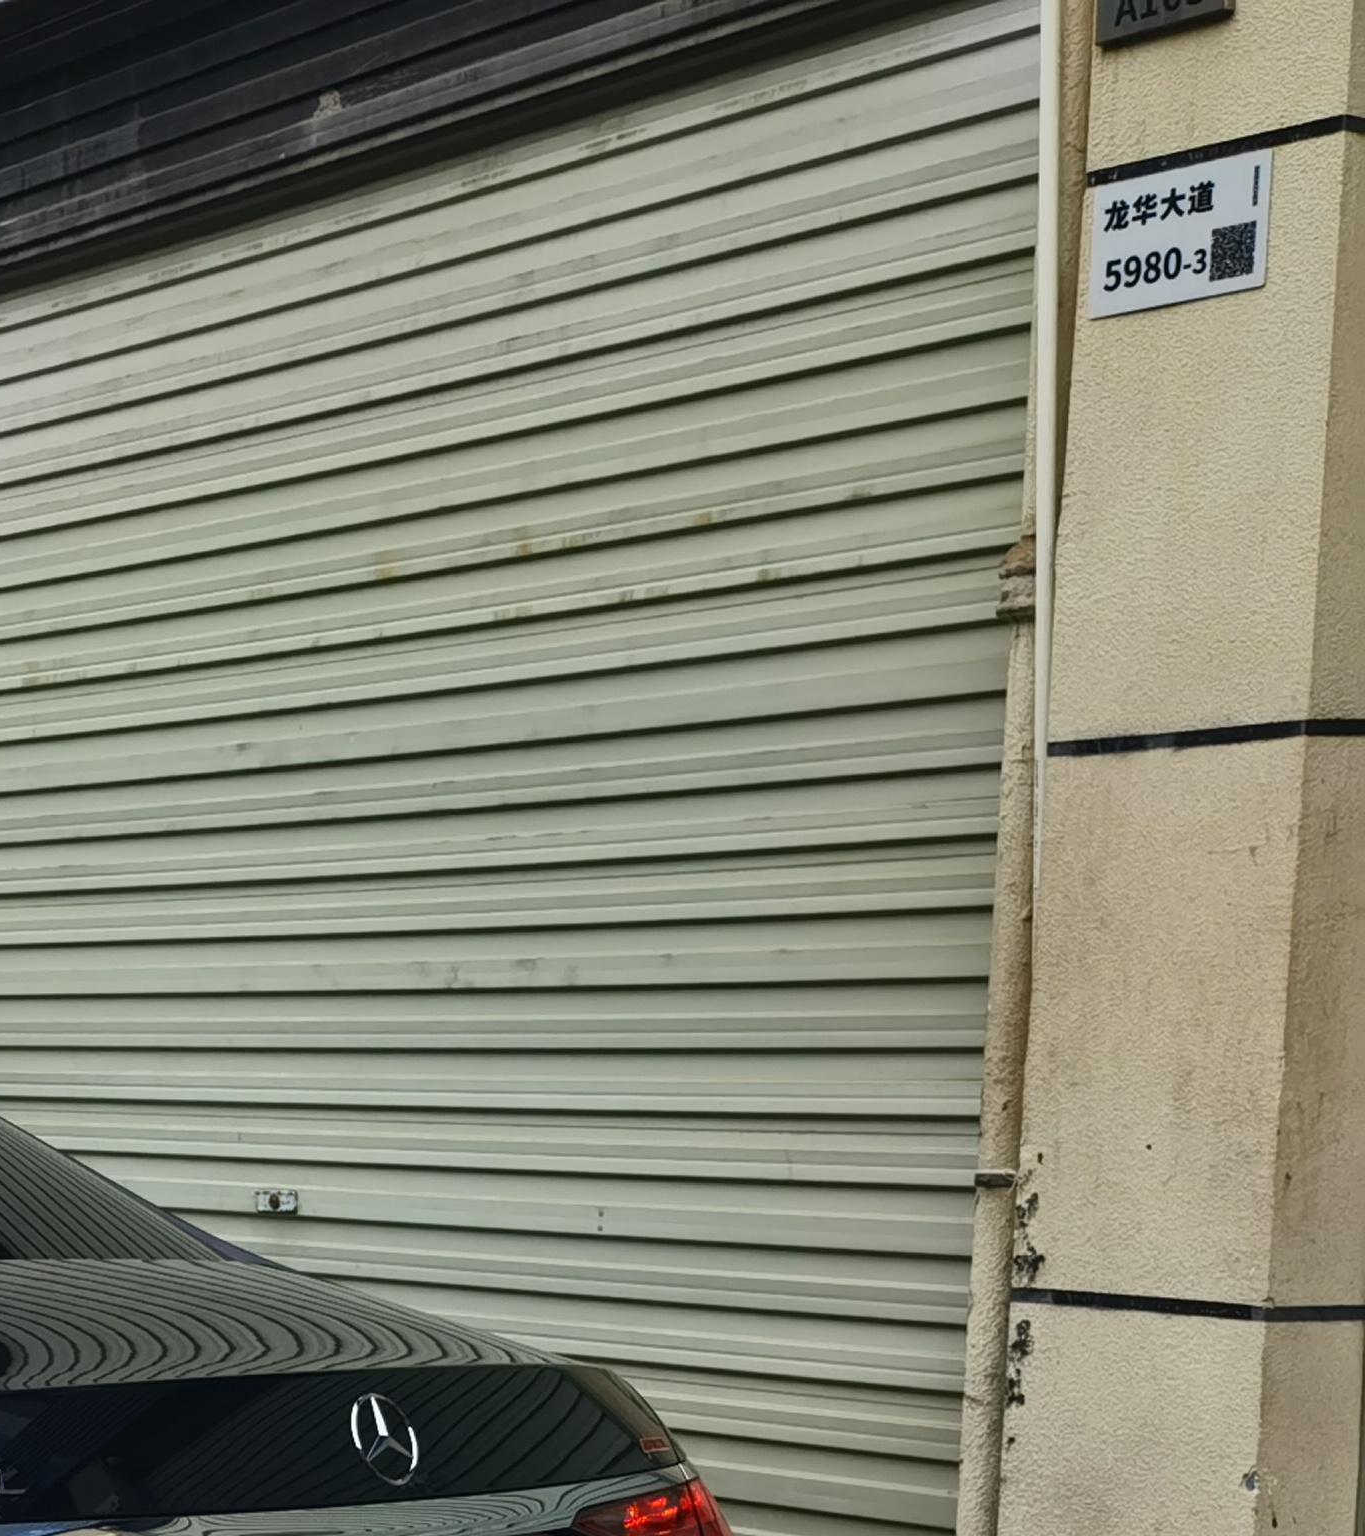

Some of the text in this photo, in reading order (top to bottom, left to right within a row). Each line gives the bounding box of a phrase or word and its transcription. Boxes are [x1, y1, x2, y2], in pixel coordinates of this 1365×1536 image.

[1103, 180, 1216, 232] 龙华大道
[1103, 247, 1208, 292] 5980-3
